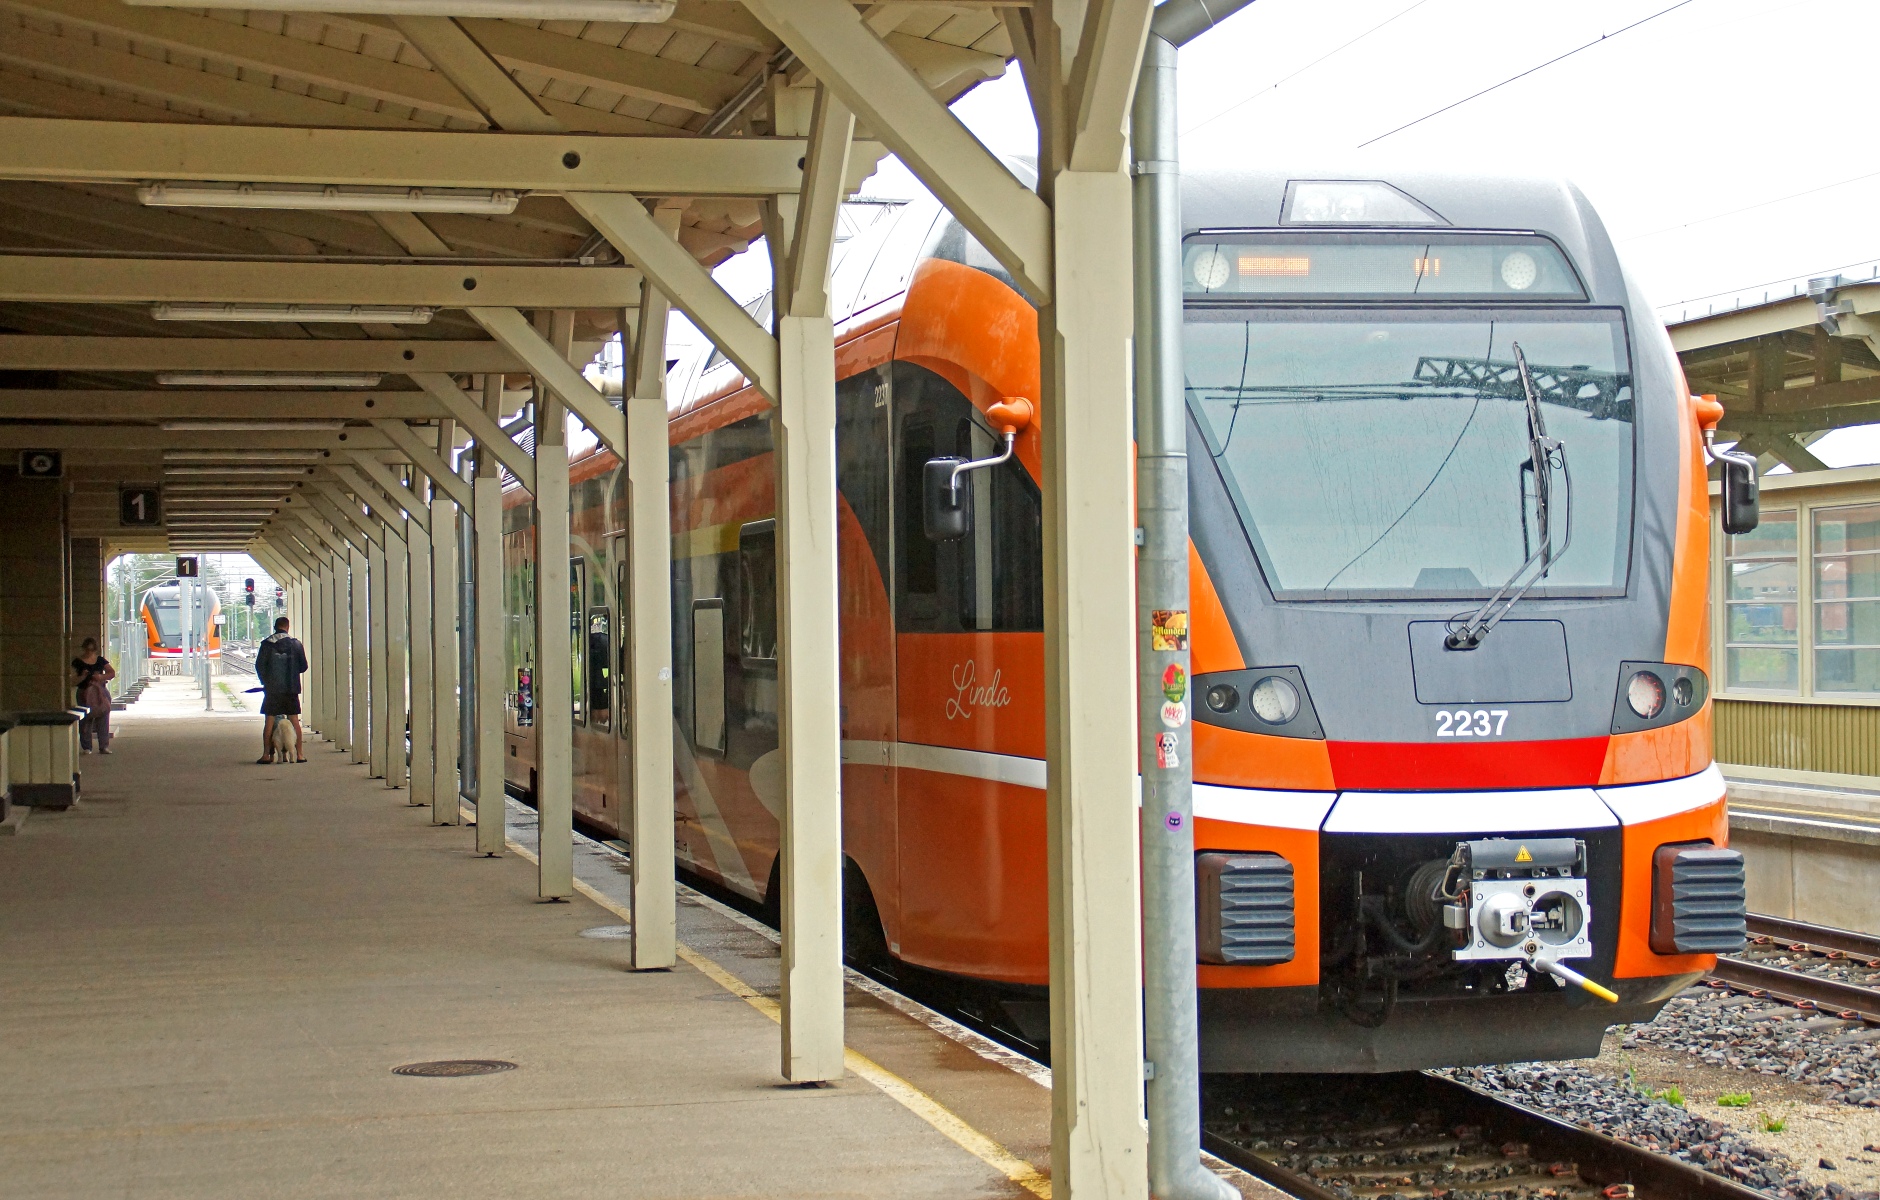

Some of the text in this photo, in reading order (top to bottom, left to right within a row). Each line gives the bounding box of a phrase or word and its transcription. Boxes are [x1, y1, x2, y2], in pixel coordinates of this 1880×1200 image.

[875, 383, 889, 408] 2237
[131, 493, 145, 520] 1
[182, 560, 190, 575] 1
[946, 659, 1011, 720] Linda
[1435, 709, 1509, 737] 2237
